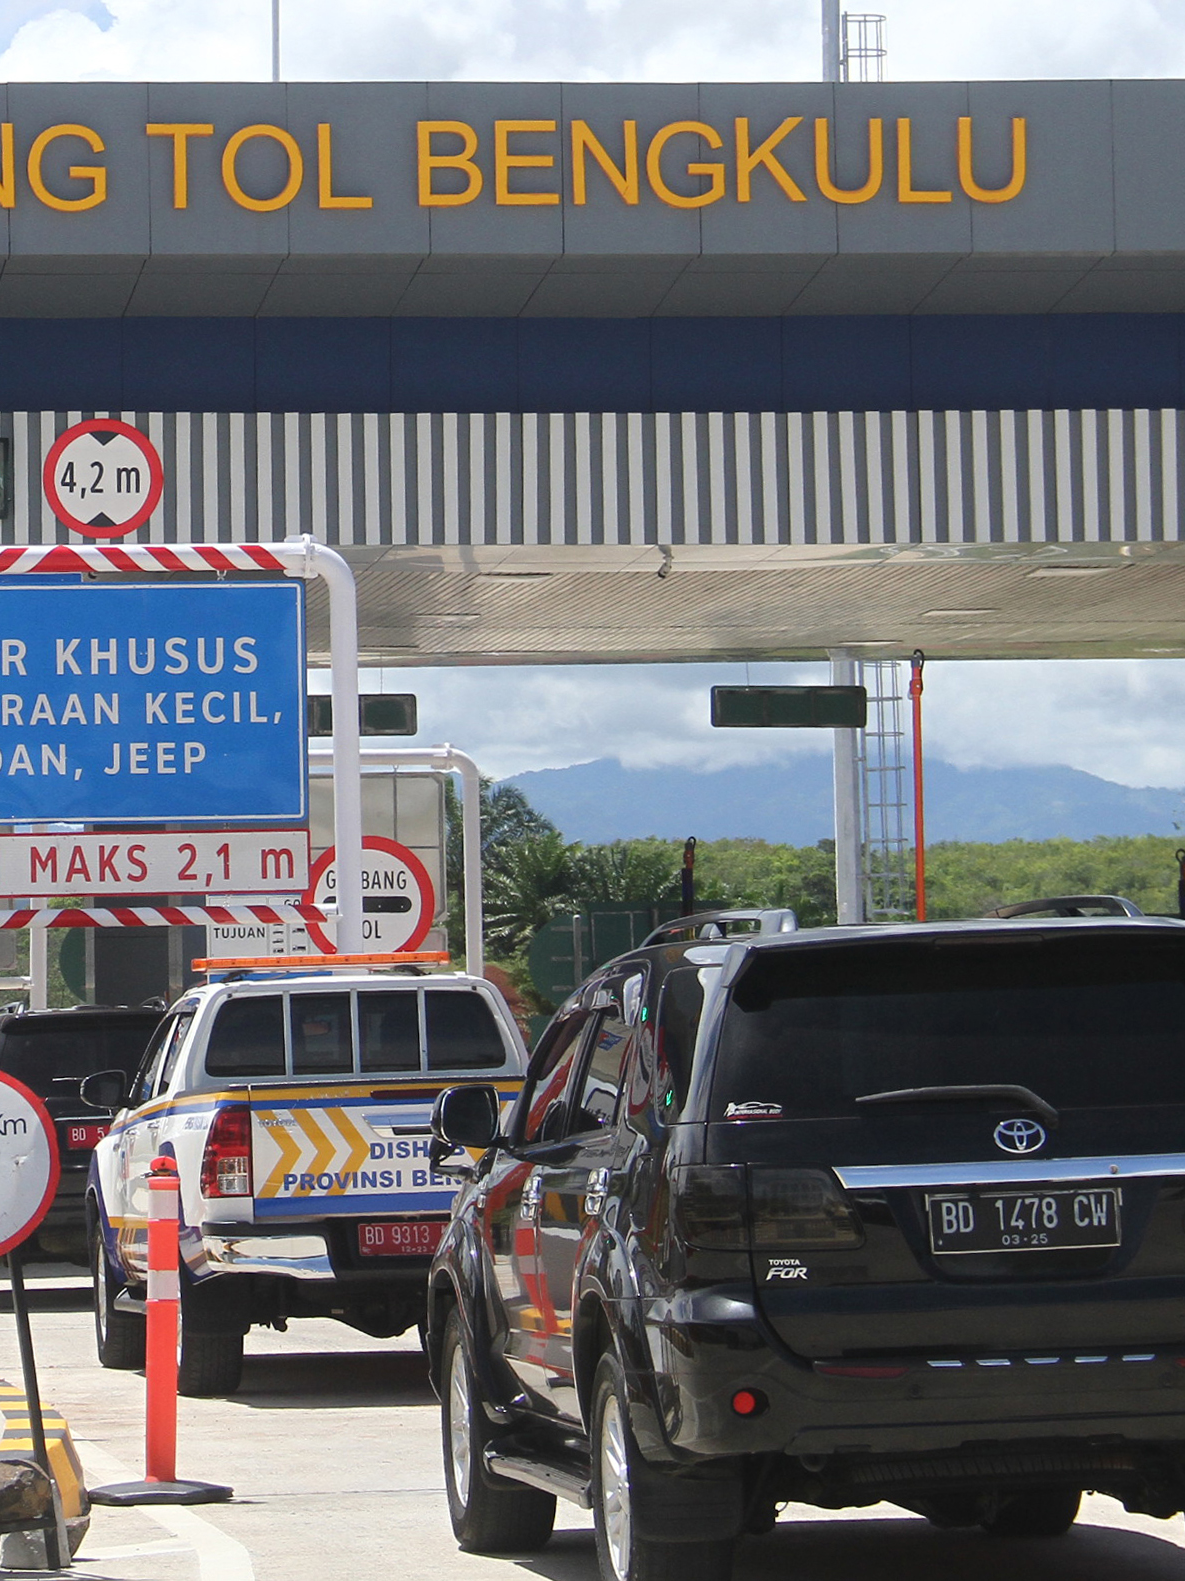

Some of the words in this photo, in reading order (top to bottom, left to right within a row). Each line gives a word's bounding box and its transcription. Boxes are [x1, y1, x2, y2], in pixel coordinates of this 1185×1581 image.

[146, 122, 373, 211] TOL
[418, 116, 1026, 209] BENGKULU
[60, 460, 104, 499] 4,2
[116, 465, 141, 493] m
[56, 636, 259, 676] KHUSUS
[146, 691, 283, 725] KECIL,
[105, 741, 207, 774] JEEP
[30, 843, 149, 883] MAKS
[178, 842, 231, 888] 2,1
[261, 846, 294, 880] m
[326, 870, 407, 889] GBANG
[214, 927, 266, 939] TUJUAN
[362, 920, 382, 939] OL
[71, 1127, 86, 1141] BD
[283, 1170, 402, 1191] PROVINSI
[941, 1201, 975, 1234] BD
[995, 1197, 1058, 1231] 1478
[1073, 1194, 1107, 1227] CW
[366, 1227, 384, 1244] BD
[392, 1225, 430, 1243] 9313
[768, 1258, 801, 1266] TOYOTA
